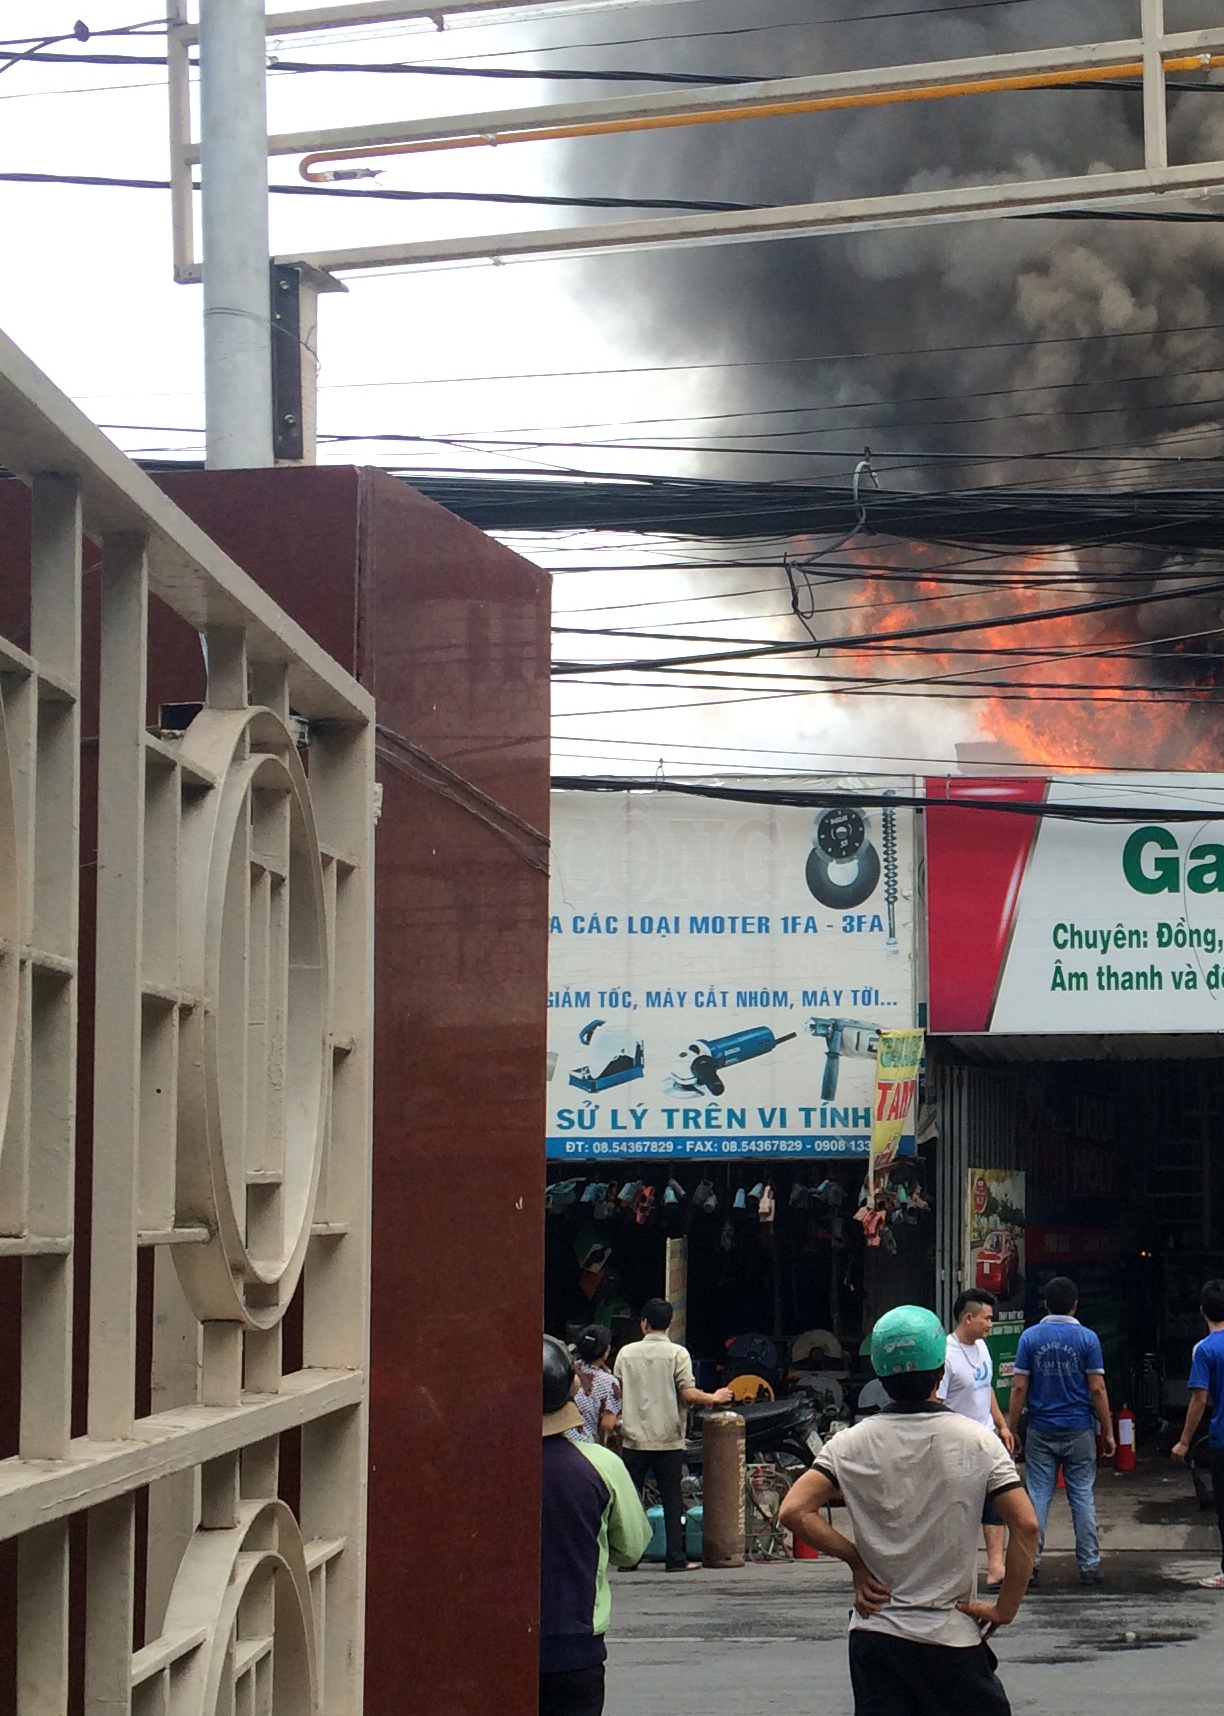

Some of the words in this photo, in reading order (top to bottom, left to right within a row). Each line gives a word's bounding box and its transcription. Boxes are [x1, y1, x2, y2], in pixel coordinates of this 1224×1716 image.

[573, 912, 618, 934] CÁC
[628, 916, 680, 938] LOẠI
[690, 916, 770, 934] MOTER
[780, 915, 818, 934] 1FA
[842, 914, 883, 933] 3FA
[1053, 922, 1148, 954] Chuyên:
[1156, 917, 1223, 952] Đồng,
[1051, 959, 1088, 991] Âm
[1096, 964, 1163, 991] thanh
[1170, 963, 1197, 990] và
[598, 986, 638, 1010] TỐC,
[646, 988, 687, 1008] MÁY
[736, 988, 794, 1010] NHÔM,
[802, 987, 843, 1007] MÁY
[556, 1100, 600, 1130] SỬ
[611, 1103, 649, 1130] LÝ
[661, 1102, 746, 1130] TRÊN
[758, 1108, 787, 1128] VI
[798, 1101, 871, 1128] TÍNH
[566, 1141, 589, 1153] ĐT:
[592, 1141, 674, 1153] 08.54367829
[686, 1141, 718, 1152] FAX:
[722, 1140, 802, 1152] 08.54367829
[814, 1140, 846, 1151] 0908
